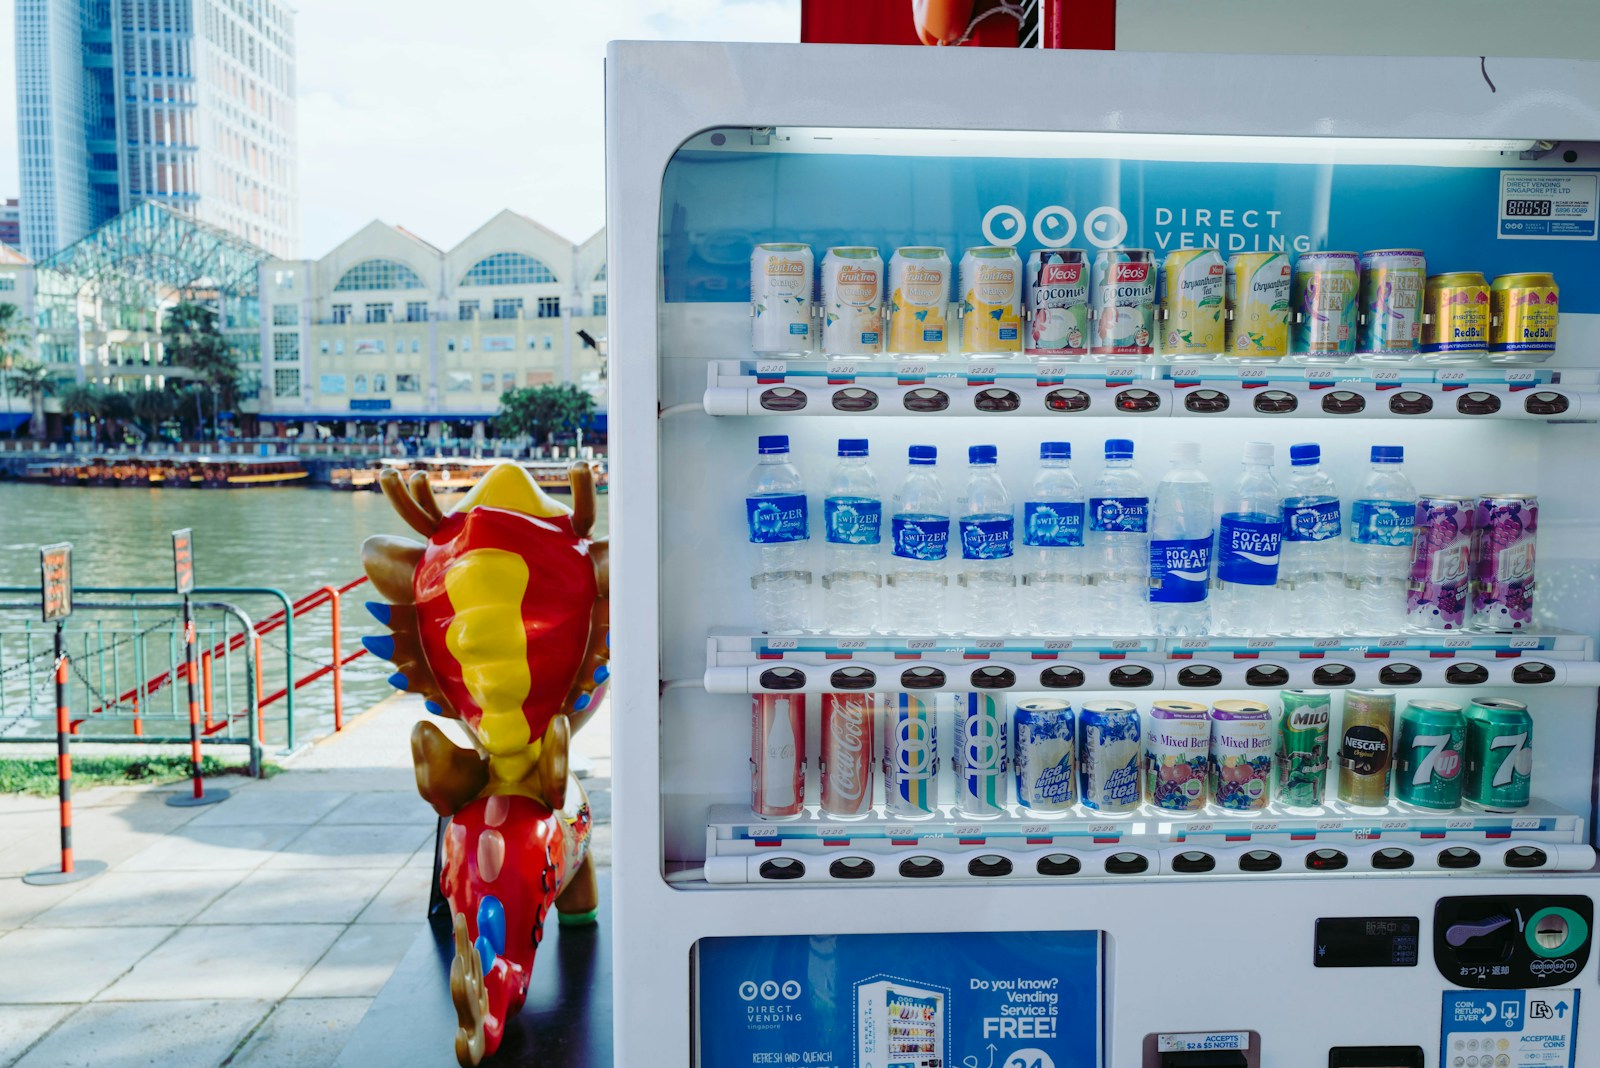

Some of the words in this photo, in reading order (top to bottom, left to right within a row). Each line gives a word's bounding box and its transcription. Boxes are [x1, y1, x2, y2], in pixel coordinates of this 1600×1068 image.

[1155, 208, 1282, 228] DIRECT
[1154, 231, 1312, 253] VENDING
[1049, 267, 1077, 281] Yeo's
[1116, 265, 1144, 279] Yeo's
[1307, 276, 1353, 293] GREEN
[1386, 272, 1424, 291] GREEN
[1202, 287, 1212, 296] Tea
[1274, 288, 1283, 298] Tea
[1319, 293, 1343, 311] TEA
[1394, 292, 1417, 308] TEA
[760, 508, 803, 522] SWITZER
[1103, 506, 1144, 515] SWITZER
[1298, 510, 1339, 524] SWITZER
[838, 514, 878, 524] SWITZER
[1036, 516, 1080, 525] SWITZER
[904, 531, 947, 542] SWITZER
[967, 530, 1009, 542] SWITZER
[1232, 530, 1281, 543] POCARI
[1232, 540, 1278, 552] SWEAT
[1166, 547, 1209, 560] POCARI
[1166, 558, 1207, 569] SWEAT
[1293, 711, 1328, 726] MILO
[830, 694, 864, 801] Coca-Cola
[964, 714, 1000, 781] 100
[1160, 734, 1189, 748] Mixed
[1221, 735, 1249, 749] Mixed
[894, 717, 931, 785] 100
[1489, 732, 1528, 788] 7
[1041, 764, 1063, 778] ice
[1110, 766, 1132, 781] ice
[1035, 769, 1071, 788] lemon
[1104, 770, 1138, 790] lemon
[1042, 781, 1069, 798] tea
[1111, 783, 1137, 799] tea
[1366, 921, 1397, 936] 販売中
[1318, 944, 1326, 957] ¥
[1459, 966, 1510, 976] おつり・返却
[970, 978, 989, 990] Do
[992, 980, 1015, 992] you
[1018, 977, 1059, 989] know?
[1006, 991, 1058, 1005] Vending
[747, 1005, 792, 1014] DIRECT
[1000, 1004, 1046, 1016] Service
[1048, 1004, 1059, 1016] is
[1454, 1007, 1485, 1015] RETURN
[747, 1013, 802, 1022] VENDING
[1454, 1014, 1478, 1022] LEVER
[747, 1023, 781, 1031] singapore
[983, 1016, 1057, 1039] FREE!
[1186, 1042, 1196, 1050] $2
[1203, 1042, 1213, 1050] $5
[1213, 1041, 1239, 1049] NOTES
[1206, 1035, 1239, 1043] ACCEPTS
[1543, 1041, 1565, 1049] COINS
[752, 1052, 783, 1064] REFRESH
[784, 1052, 800, 1063] AND
[803, 1051, 833, 1063] QUENCH
